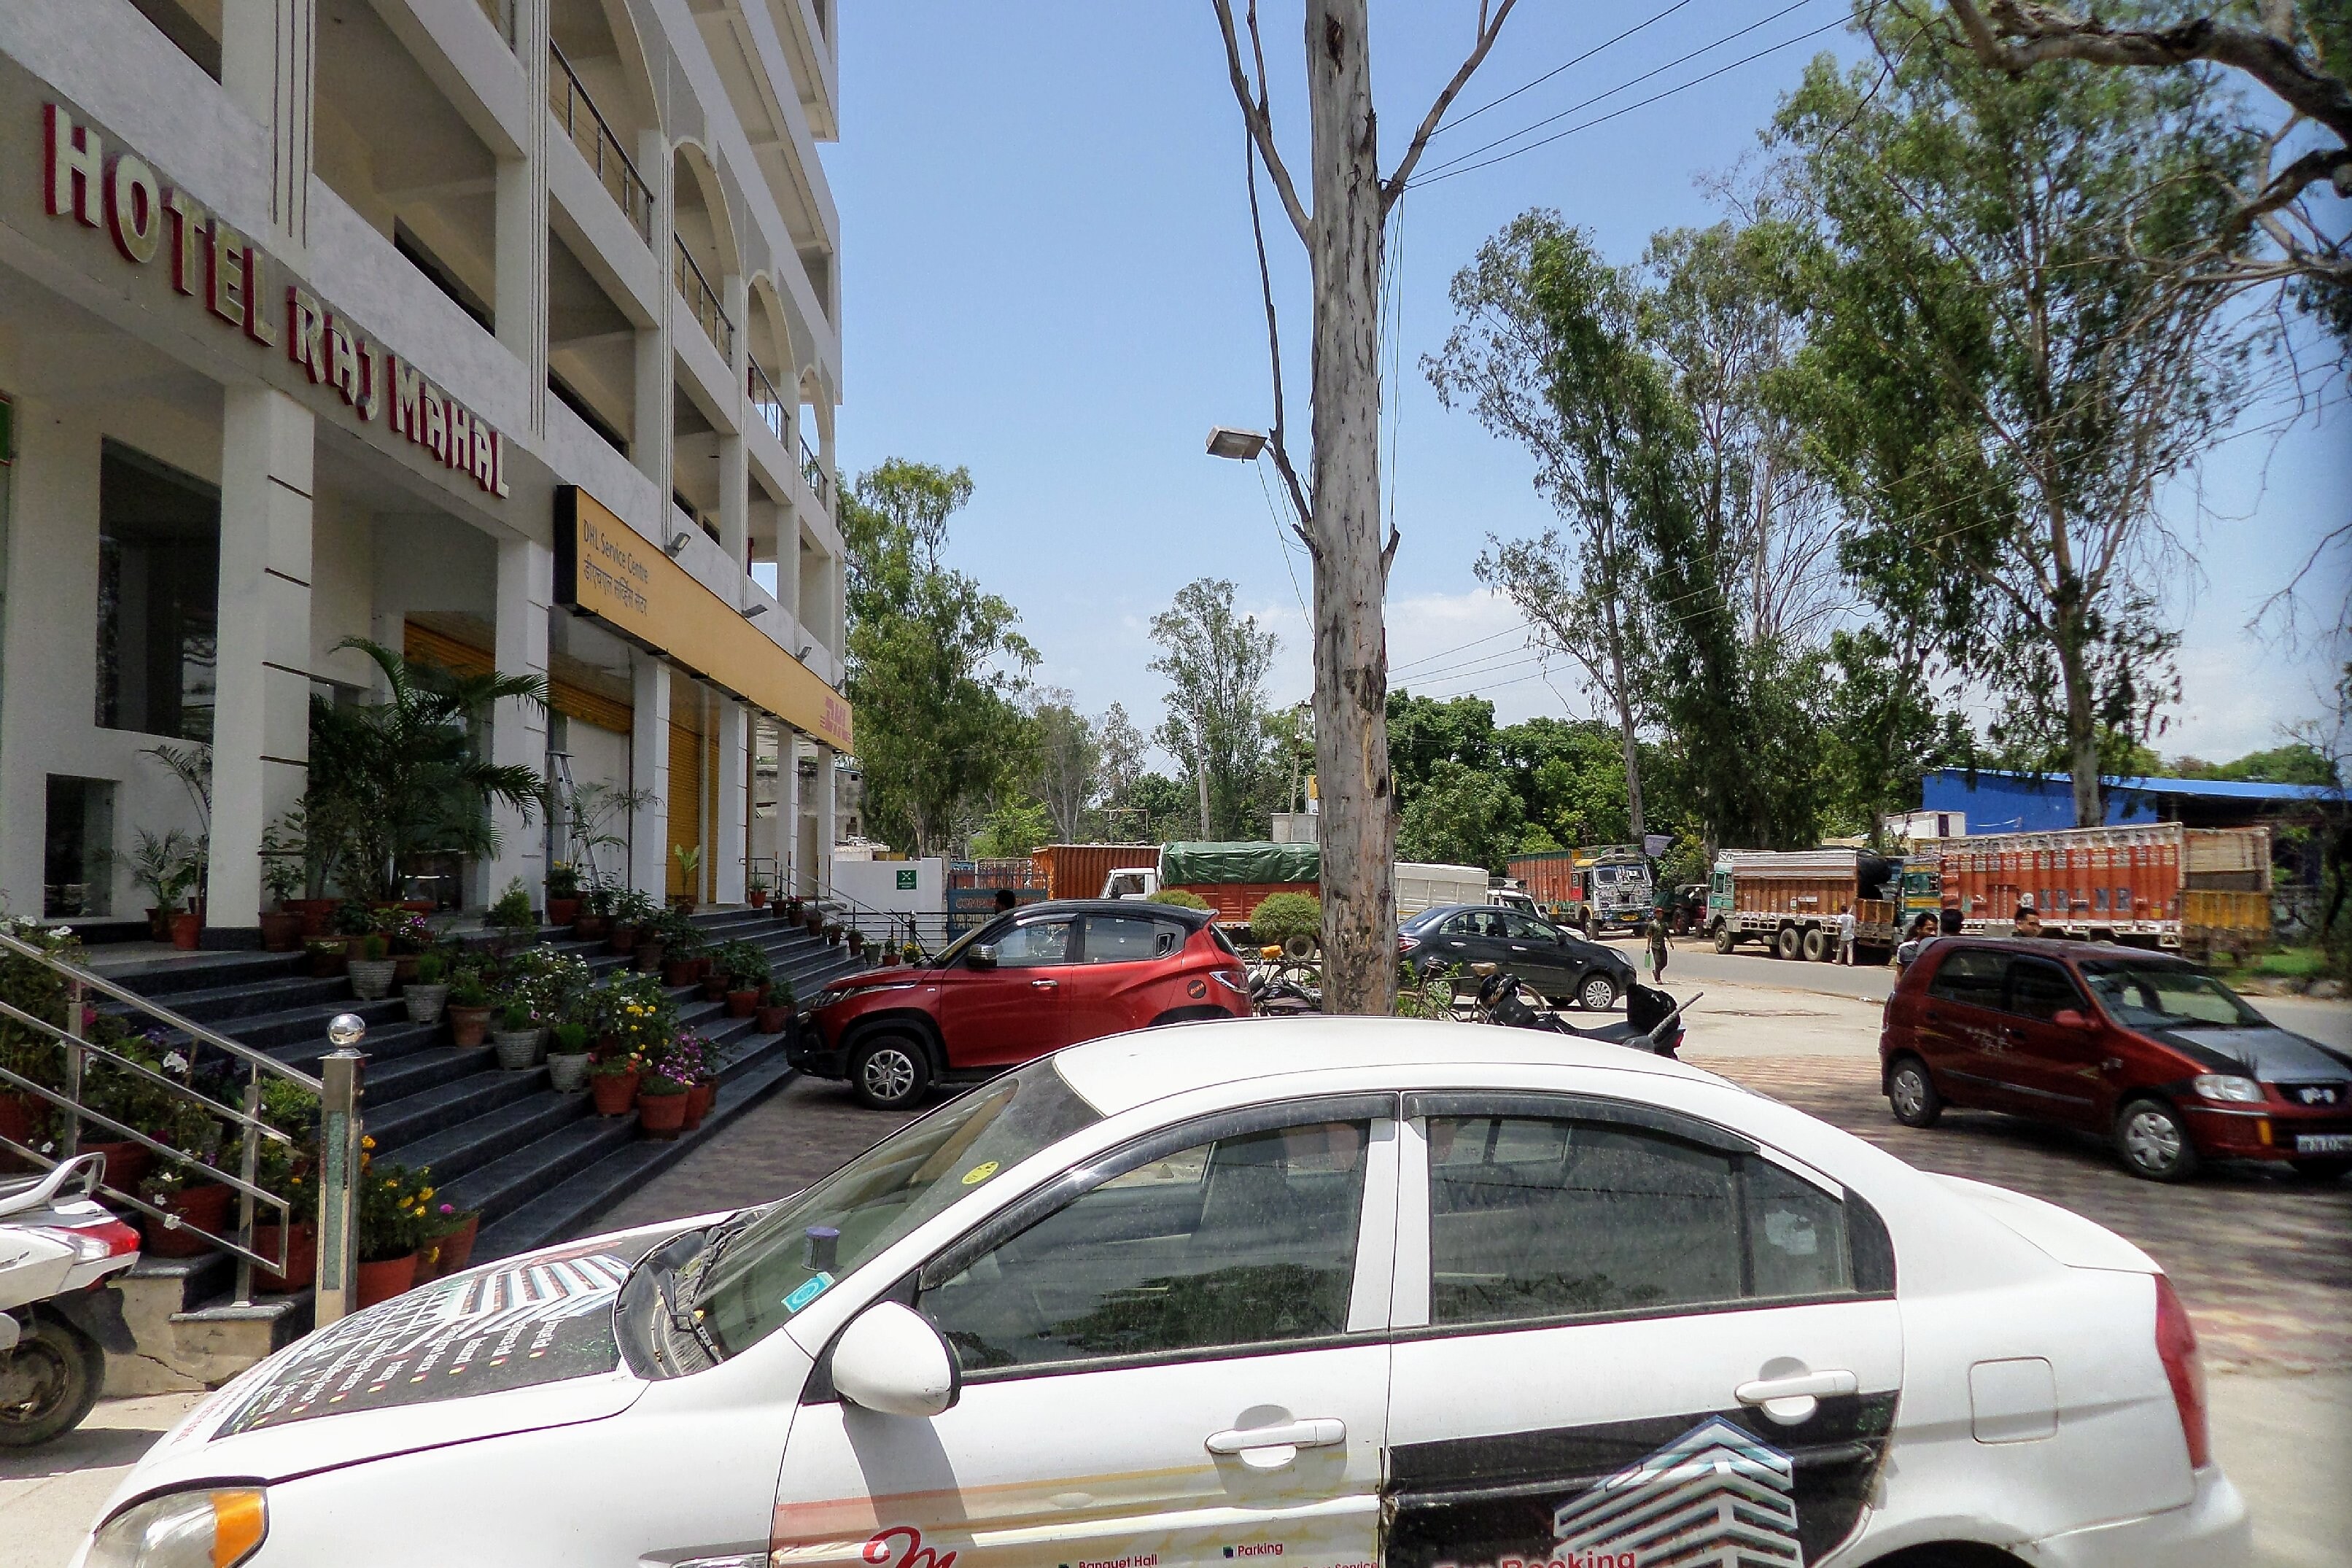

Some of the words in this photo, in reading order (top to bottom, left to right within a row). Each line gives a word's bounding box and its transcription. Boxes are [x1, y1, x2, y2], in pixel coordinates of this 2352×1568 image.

[44, 104, 276, 347] HOTEL
[287, 286, 379, 421] RAJ
[389, 355, 510, 499] MAHAL
[584, 519, 599, 551] DHL
[601, 532, 626, 569] Service
[628, 553, 648, 584] Centre
[1079, 1556, 1130, 1568] Banquet
[1135, 1554, 1157, 1567] Hall
[1238, 1542, 1283, 1556] Parking
